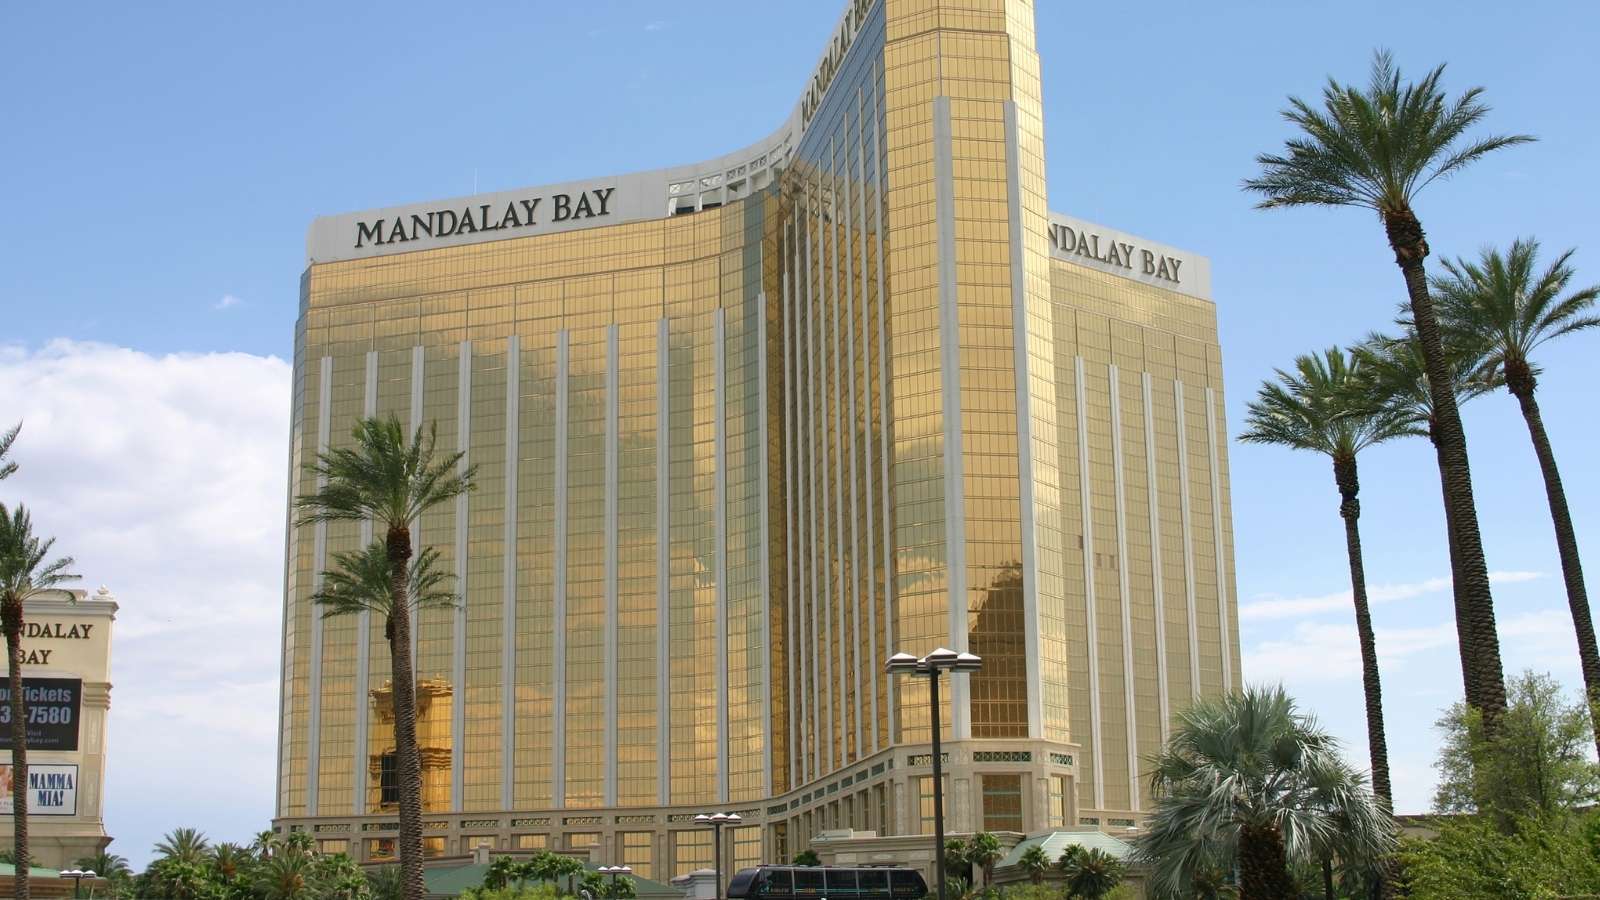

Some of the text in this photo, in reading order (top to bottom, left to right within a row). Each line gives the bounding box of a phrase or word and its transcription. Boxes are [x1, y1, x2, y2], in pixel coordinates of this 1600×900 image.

[354, 187, 616, 248] MANDALAY BAY
[1139, 248, 1183, 284] BAY
[17, 648, 52, 665] BAY
[29, 772, 73, 790] MAMMA
[37, 790, 64, 807] MIA!
